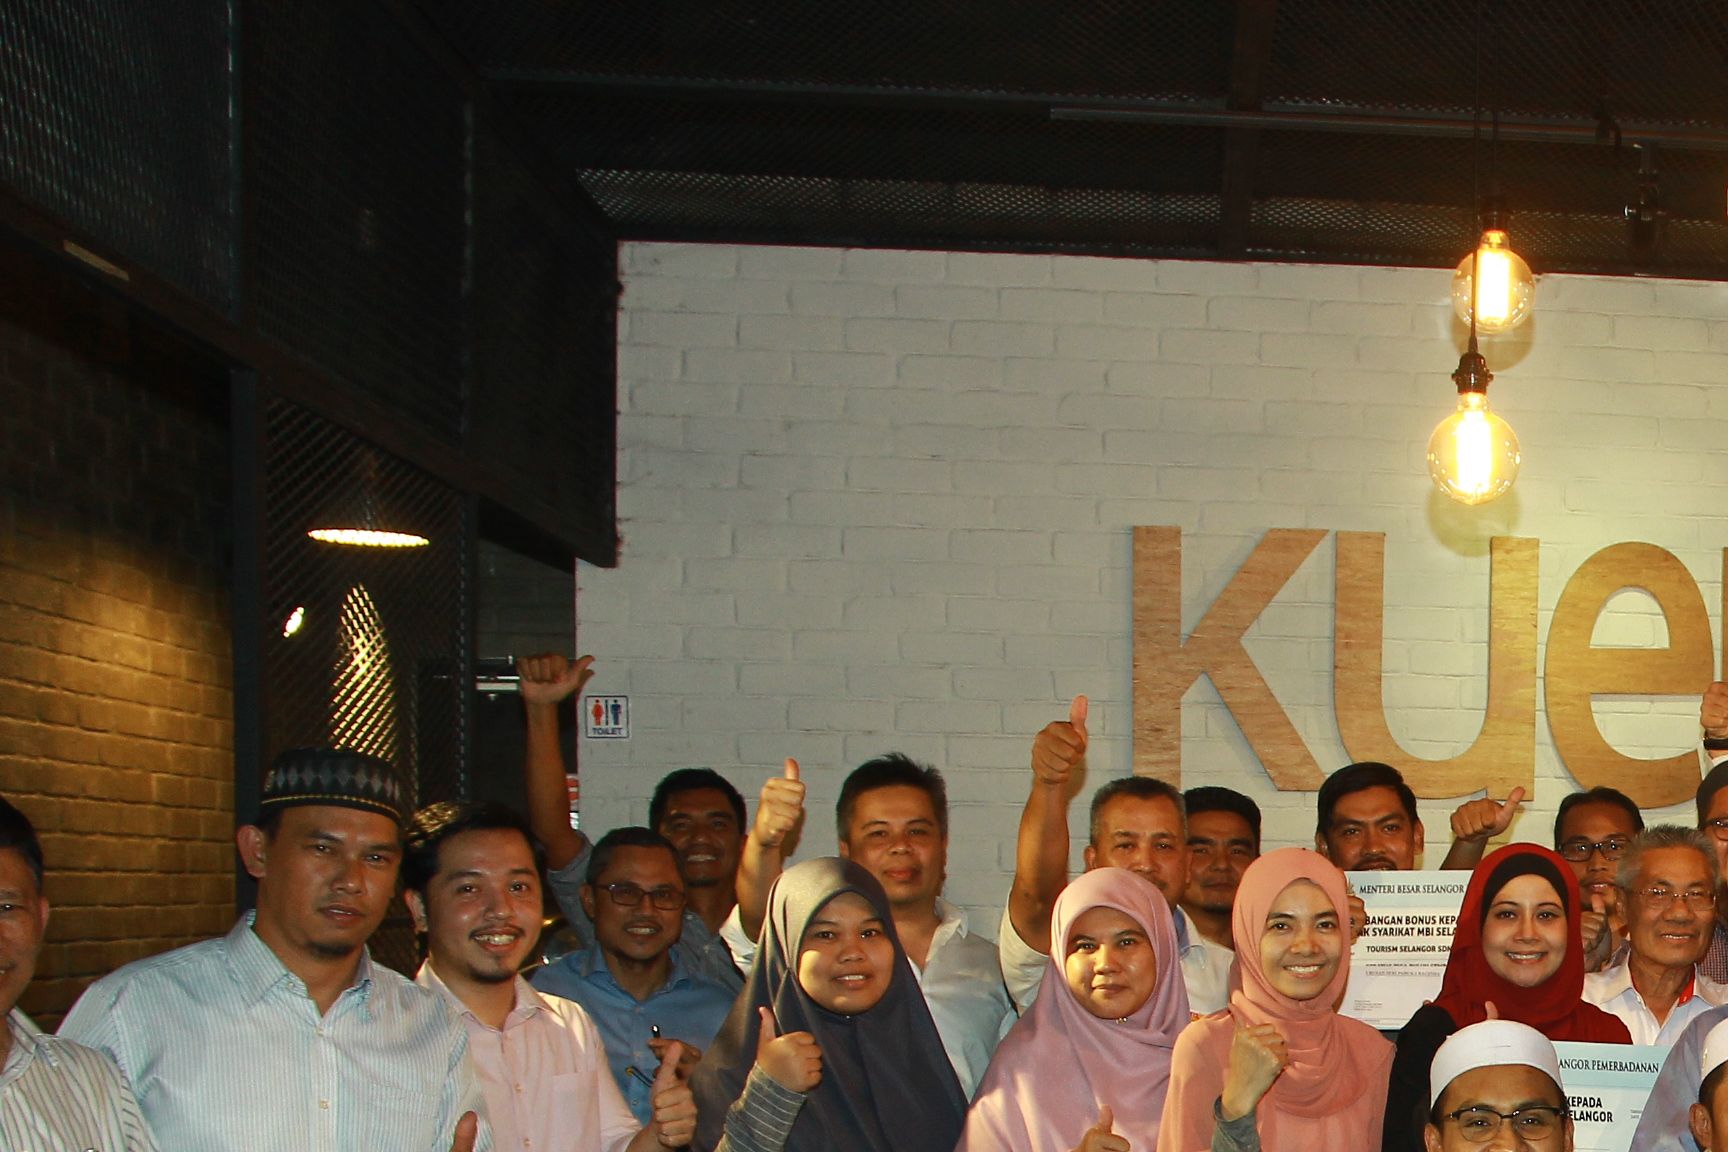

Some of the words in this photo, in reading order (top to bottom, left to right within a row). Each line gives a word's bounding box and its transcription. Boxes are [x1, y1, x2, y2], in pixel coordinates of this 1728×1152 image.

[592, 727, 622, 735] TOILET
[1359, 885, 1395, 894] MENTERI
[1397, 884, 1421, 893] BESAR
[1422, 884, 1464, 893] SELANGOR
[1405, 915, 1436, 925] BONUS
[1371, 927, 1415, 936] SYARIKAT
[1416, 927, 1434, 936] MBI
[1591, 1060, 1658, 1073] PEMERBADANAN
